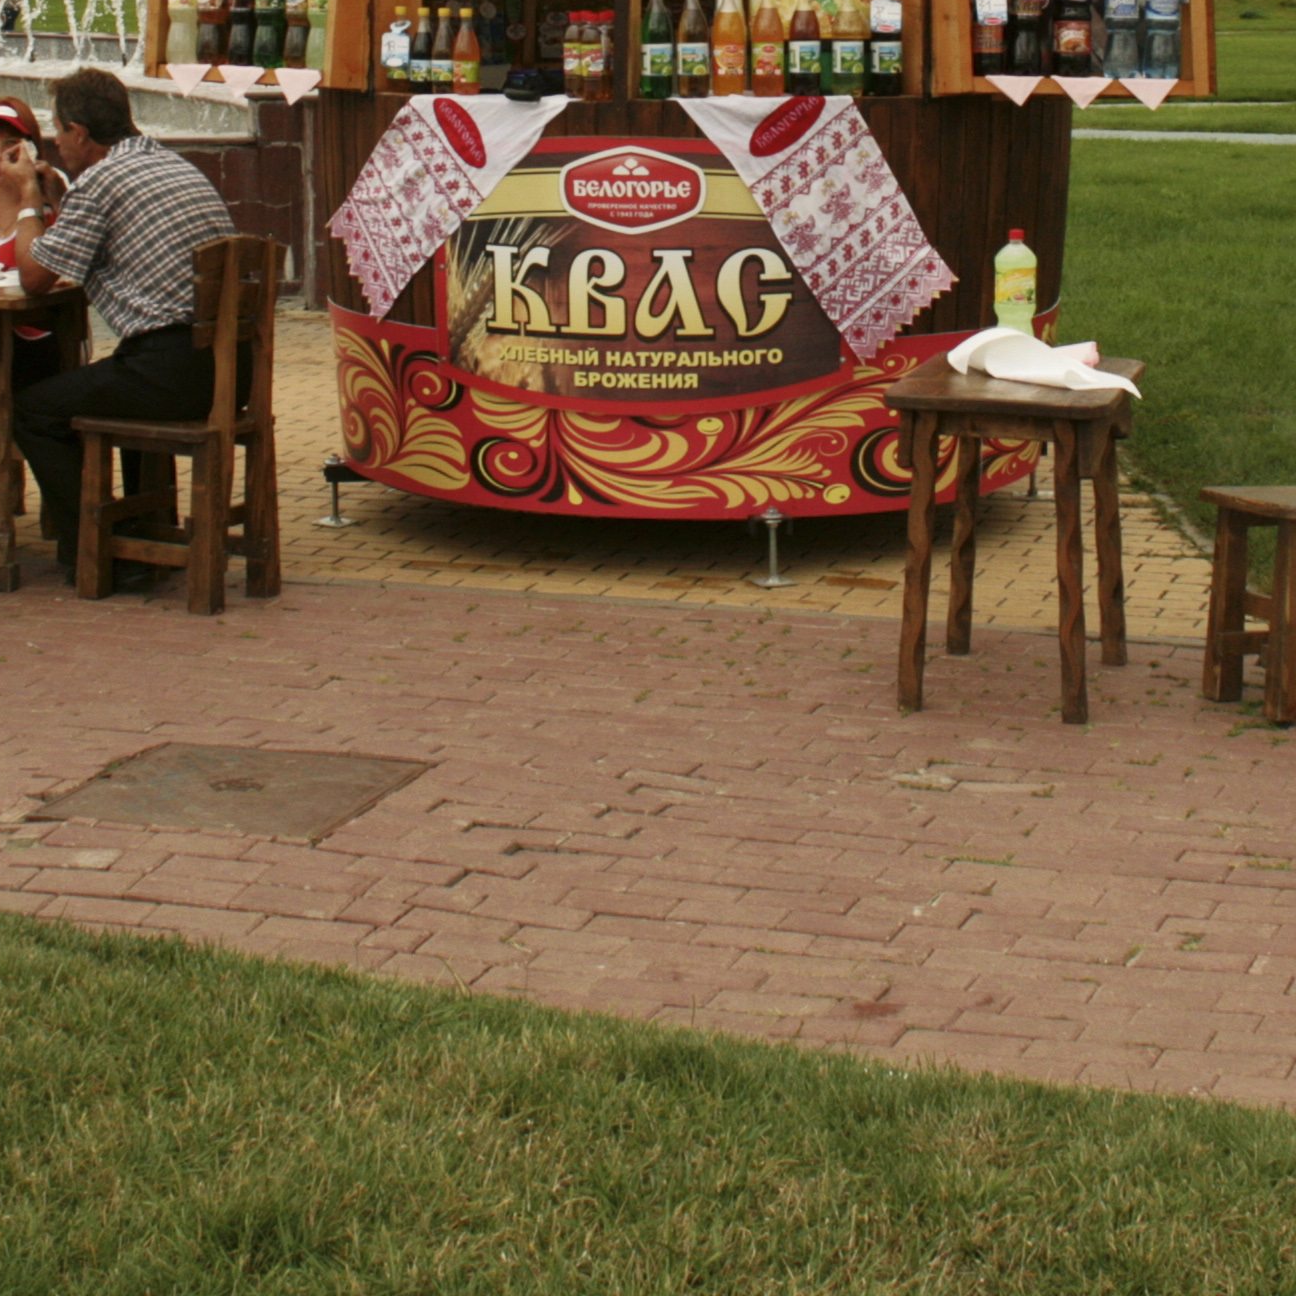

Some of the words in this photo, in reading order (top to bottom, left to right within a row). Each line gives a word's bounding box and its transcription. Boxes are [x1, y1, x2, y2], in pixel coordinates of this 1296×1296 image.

[573, 179, 692, 198] БЕЛОГОРЬЕ
[485, 244, 793, 338] КВАС
[500, 346, 599, 366] ХЛЕБНЫЙ
[605, 348, 783, 367] НАТУРАЛЬНОГО
[574, 371, 699, 389] БРОЖЕНИЯ
